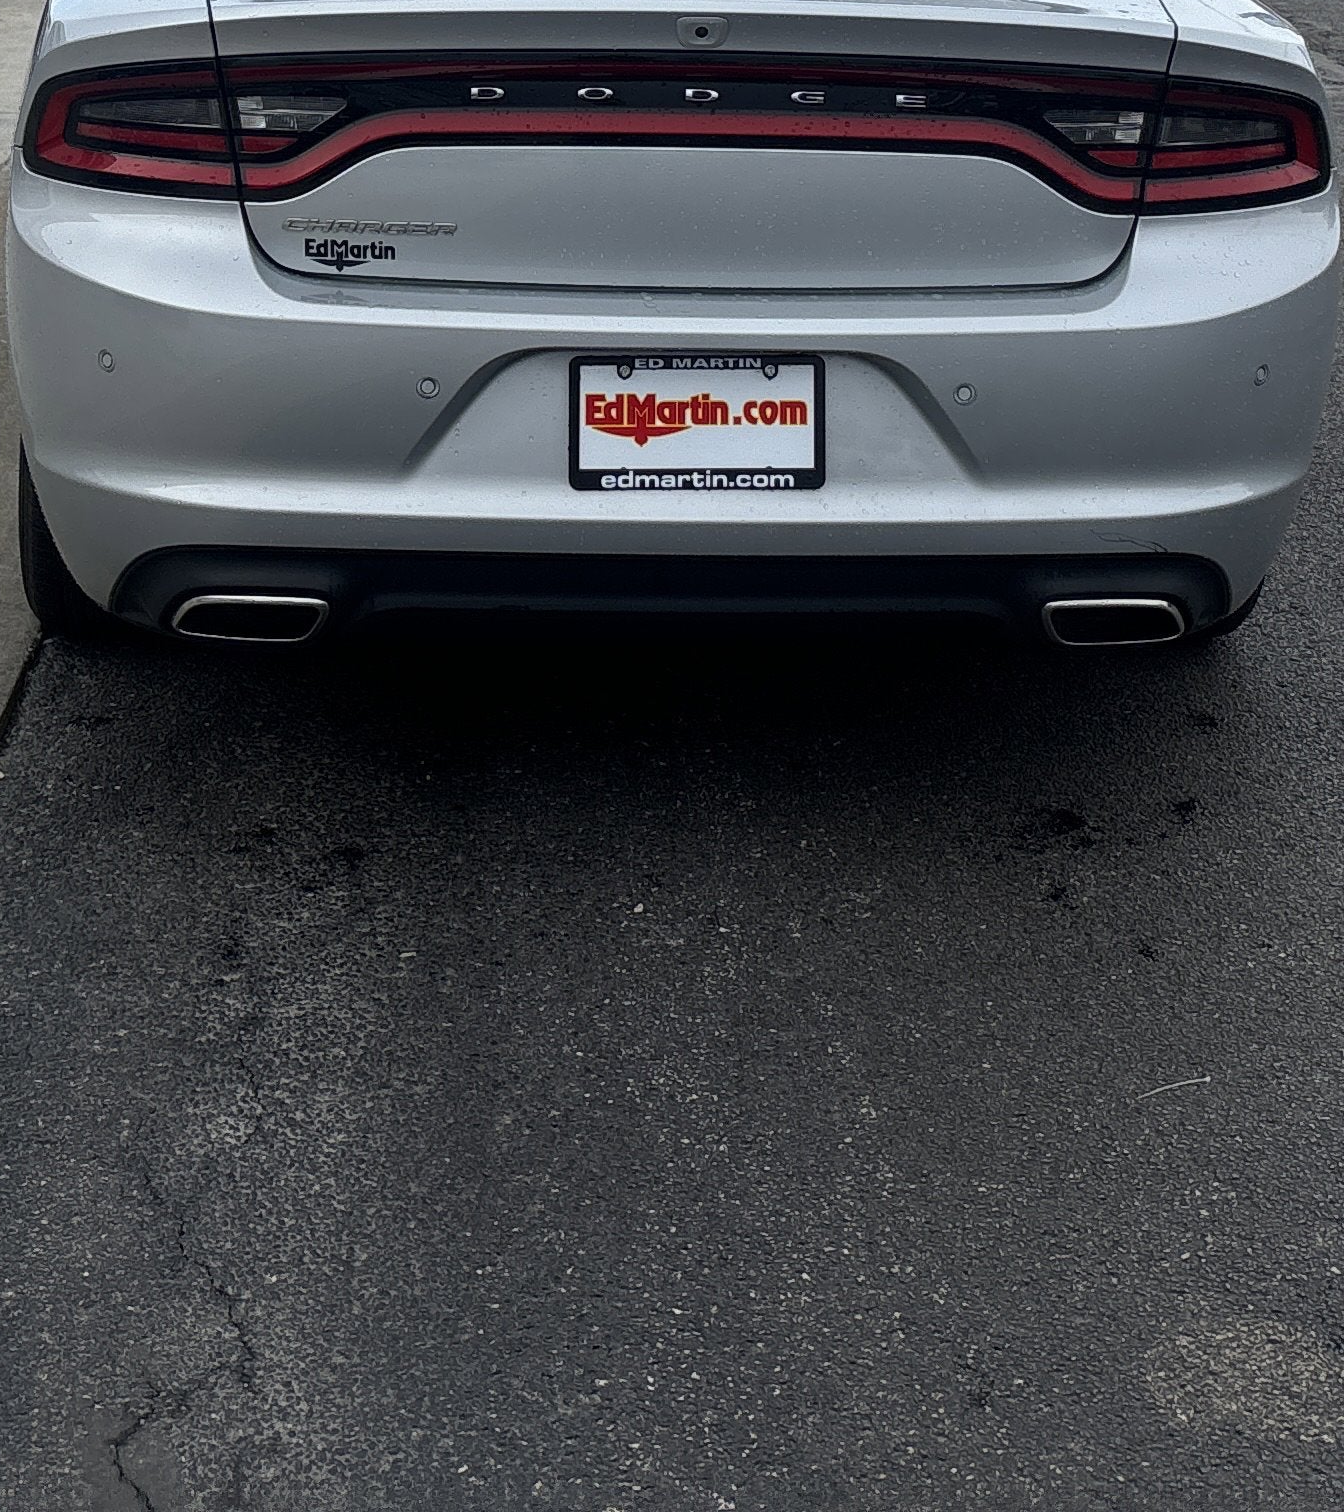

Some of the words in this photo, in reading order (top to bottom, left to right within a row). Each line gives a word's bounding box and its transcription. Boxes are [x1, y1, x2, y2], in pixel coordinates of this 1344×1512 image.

[470, 87, 927, 109] DODGE
[282, 217, 458, 237] CHARGER
[634, 358, 665, 369] ED
[672, 357, 763, 369] MARTIN
[600, 471, 795, 489] edmartin.com
